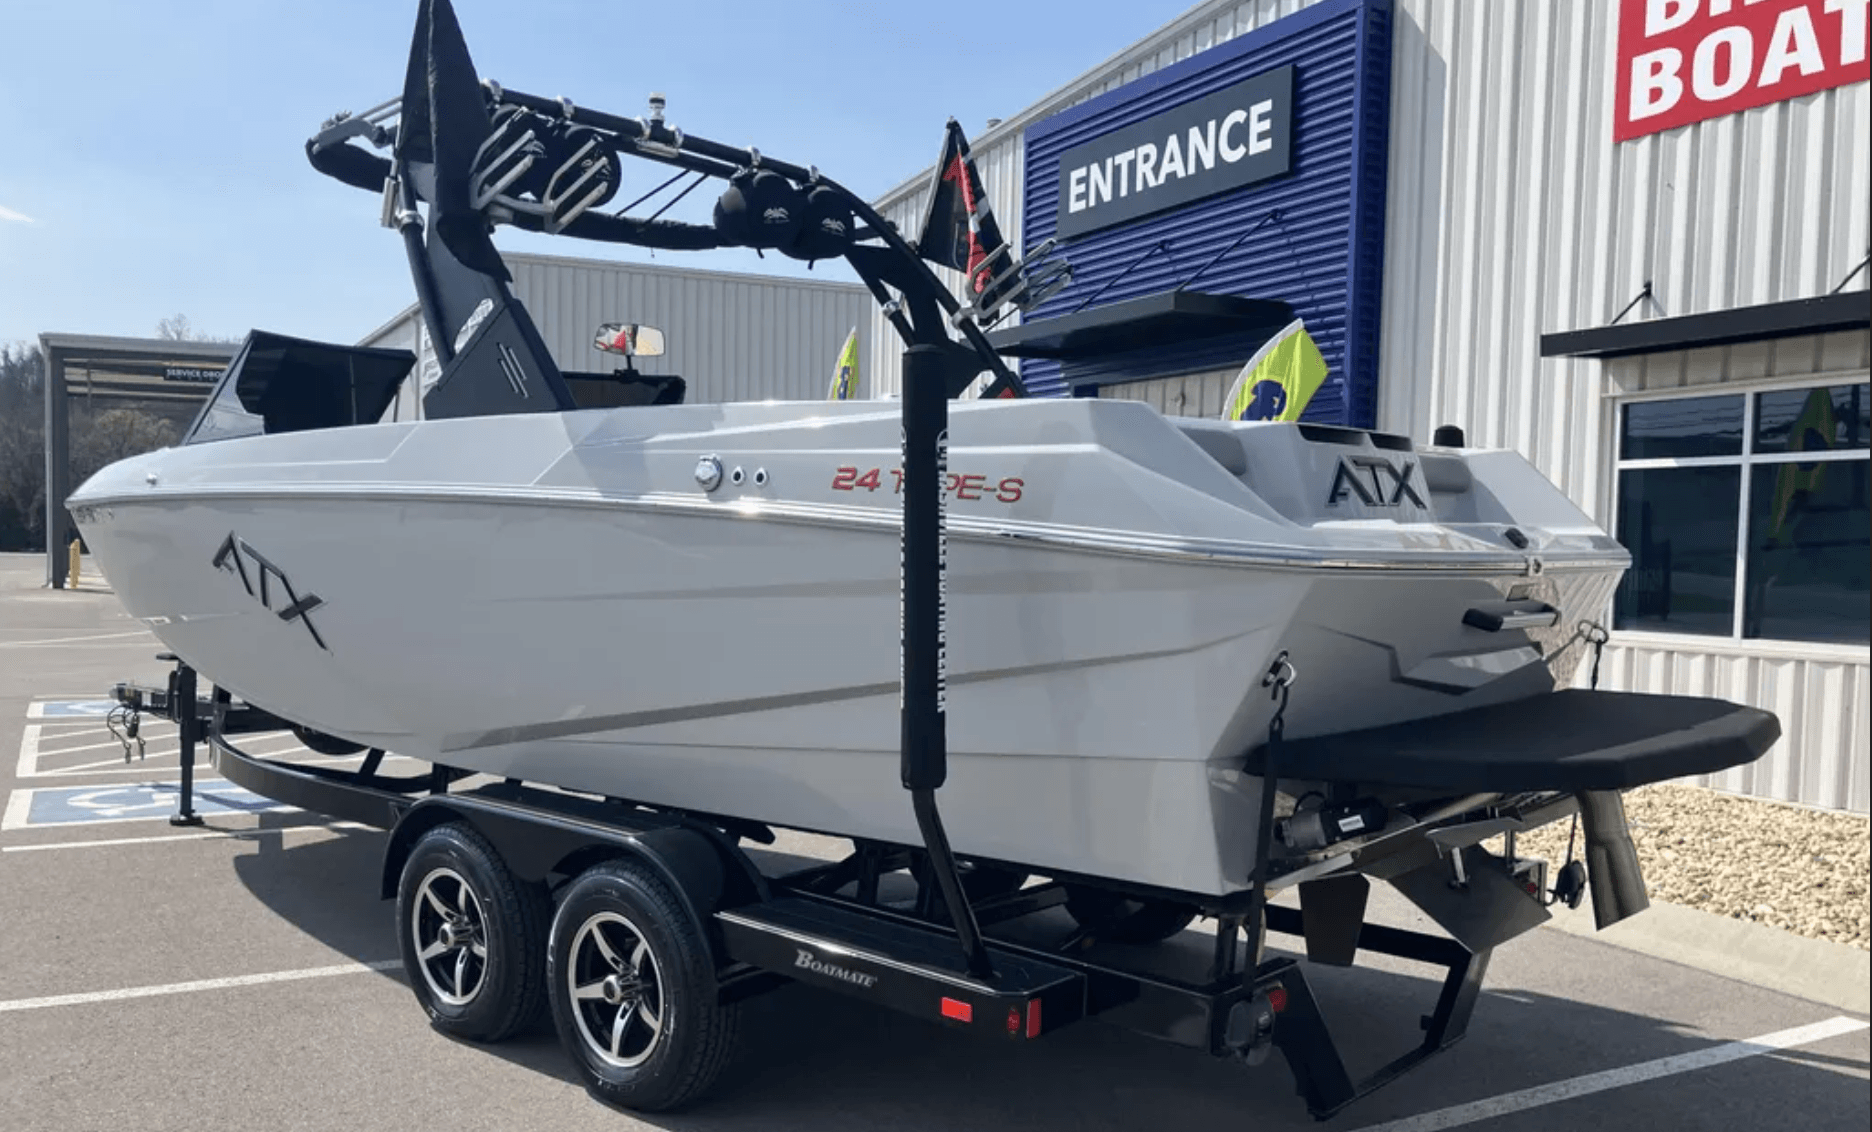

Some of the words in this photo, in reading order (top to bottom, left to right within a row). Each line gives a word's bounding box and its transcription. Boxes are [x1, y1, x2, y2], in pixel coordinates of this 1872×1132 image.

[1068, 98, 1273, 214] ENTRANCE
[832, 466, 882, 493] 24
[1324, 454, 1429, 511] ATX
[212, 530, 333, 656] ATX
